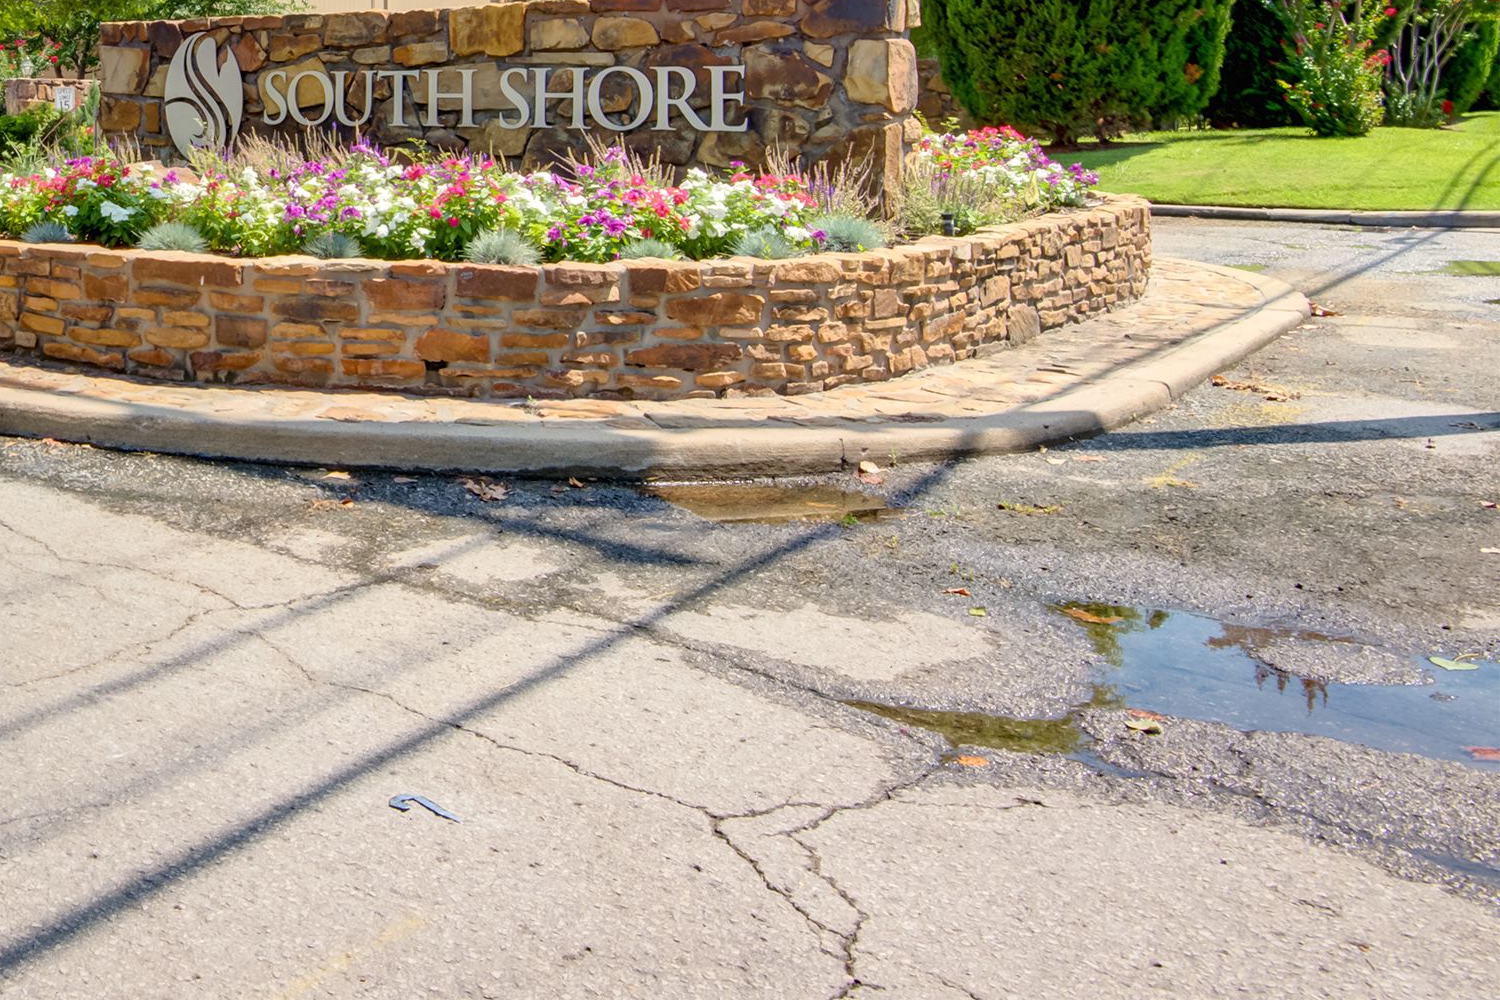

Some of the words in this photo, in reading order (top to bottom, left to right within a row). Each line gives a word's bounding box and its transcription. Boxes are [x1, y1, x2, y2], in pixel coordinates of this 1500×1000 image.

[59, 100, 70, 109] 15
[263, 68, 481, 128] SOUTH
[499, 64, 749, 132] SHORE
